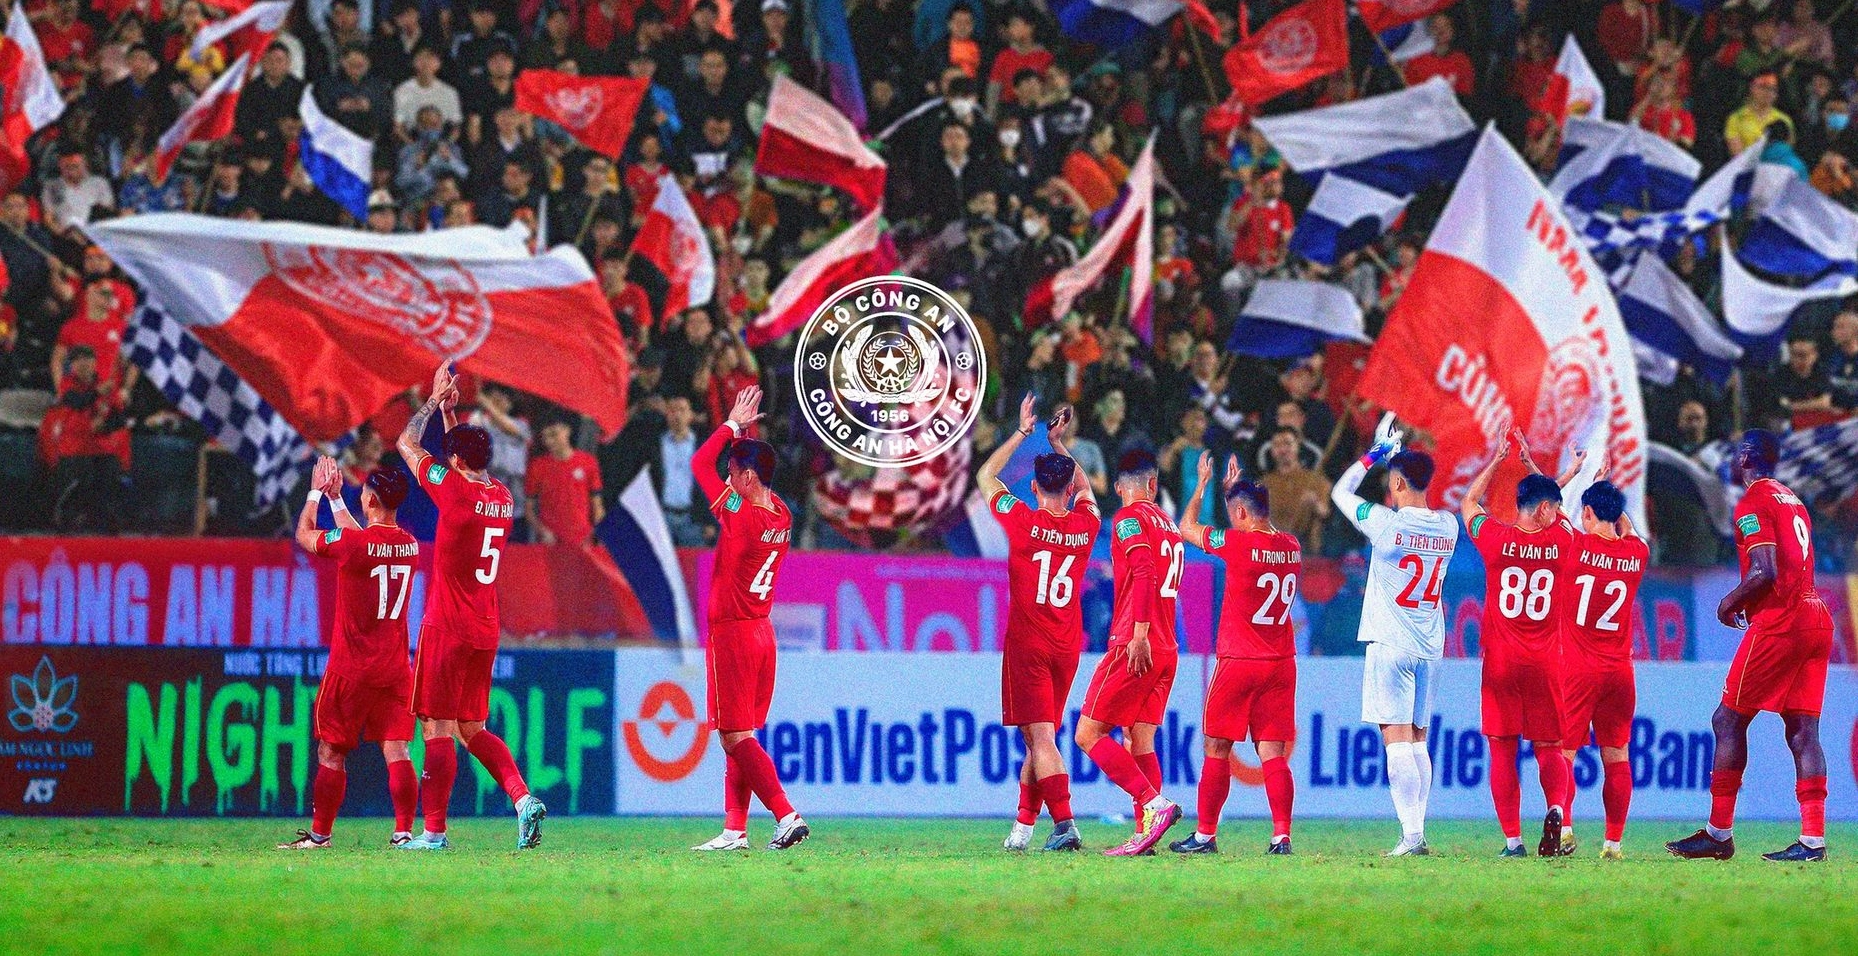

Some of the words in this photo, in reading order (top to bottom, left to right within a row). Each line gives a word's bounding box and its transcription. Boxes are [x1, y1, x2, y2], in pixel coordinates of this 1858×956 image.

[475, 527, 504, 585] 5
[1065, 531, 1090, 549] DỤNG
[1502, 542, 1516, 557] LÊ
[1519, 544, 1541, 559] VĂN
[1544, 544, 1558, 560] ĐÔ
[1792, 513, 1810, 568] 9
[4, 546, 149, 644] CÔNG
[163, 564, 237, 647] AN
[370, 564, 411, 620] 17
[749, 550, 779, 600] 4
[1031, 550, 1076, 608] 16
[1159, 539, 1185, 599] 20
[1395, 553, 1445, 609] 24
[1499, 566, 1555, 621] 88
[1251, 572, 1297, 625] 29
[1574, 574, 1628, 631] 12
